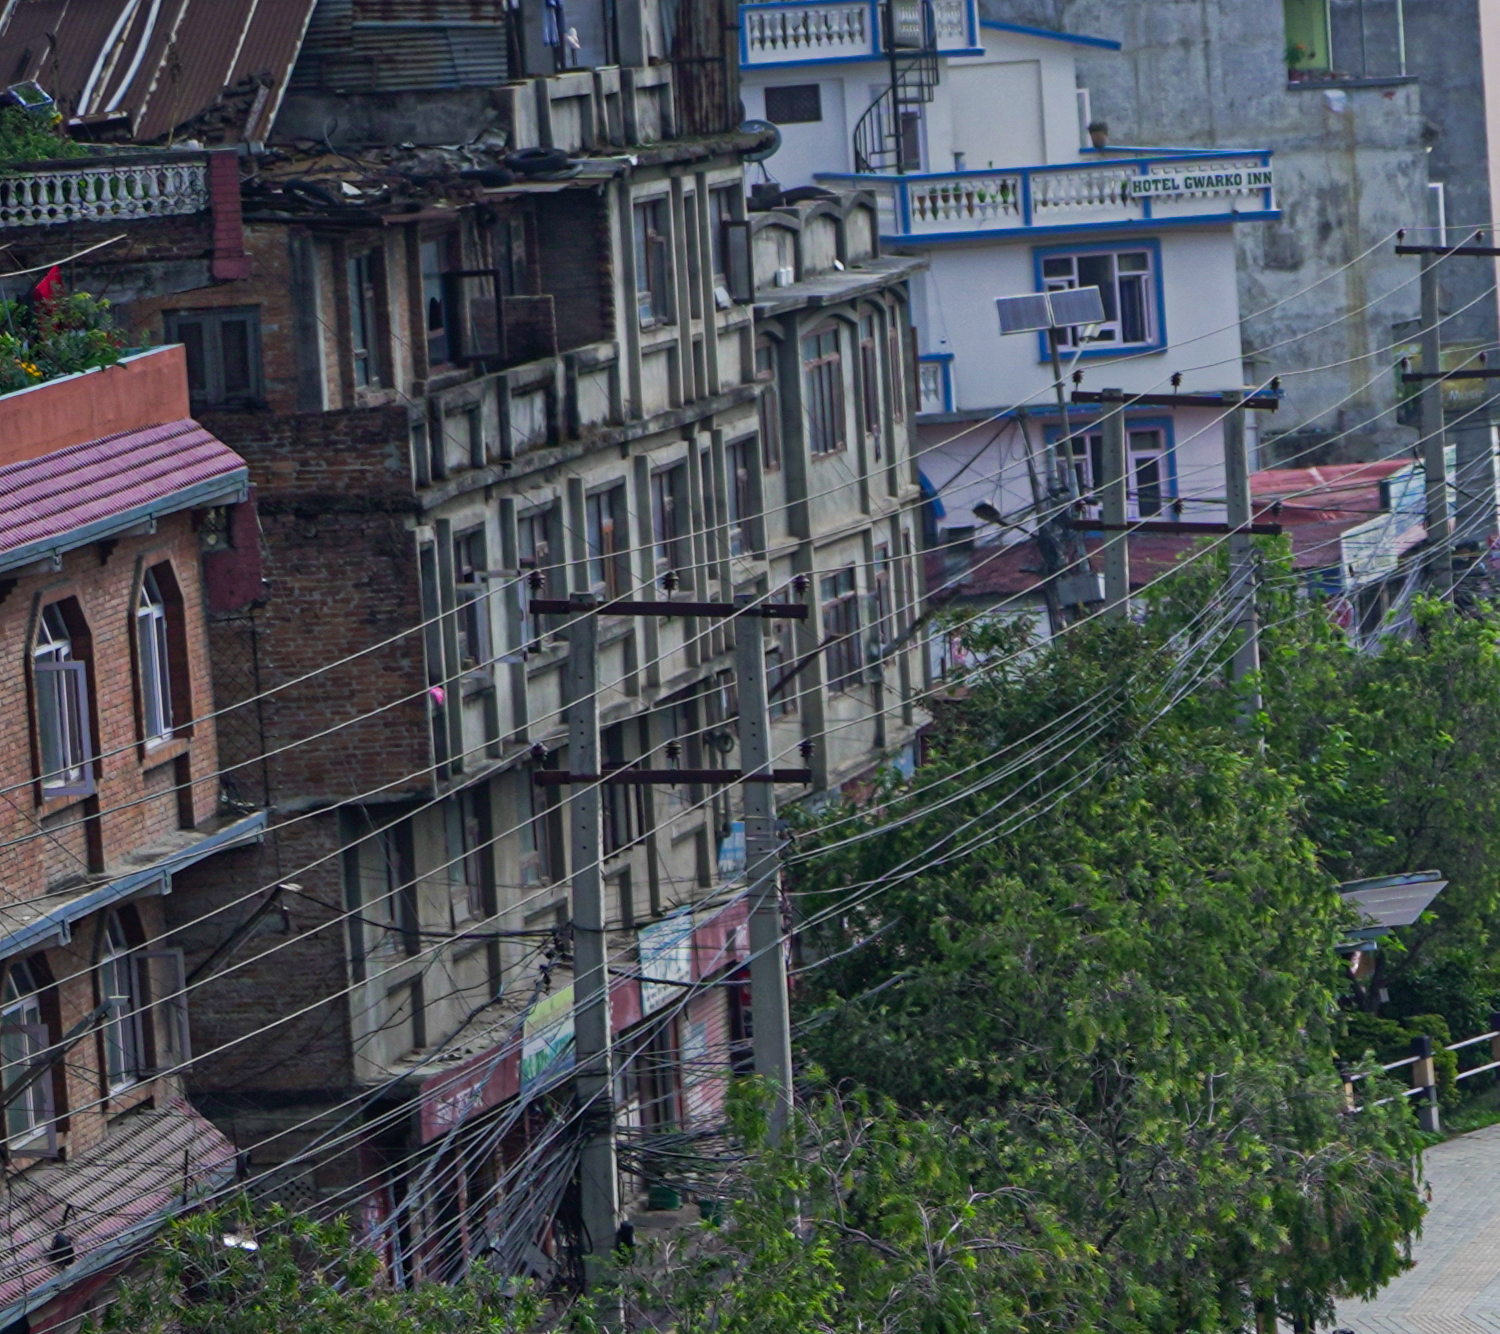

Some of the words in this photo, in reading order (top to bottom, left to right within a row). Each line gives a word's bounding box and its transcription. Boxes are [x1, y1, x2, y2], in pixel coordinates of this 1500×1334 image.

[1133, 178, 1180, 193] HOTEL
[1184, 173, 1242, 189] GWARKO
[1247, 171, 1272, 185] INN
